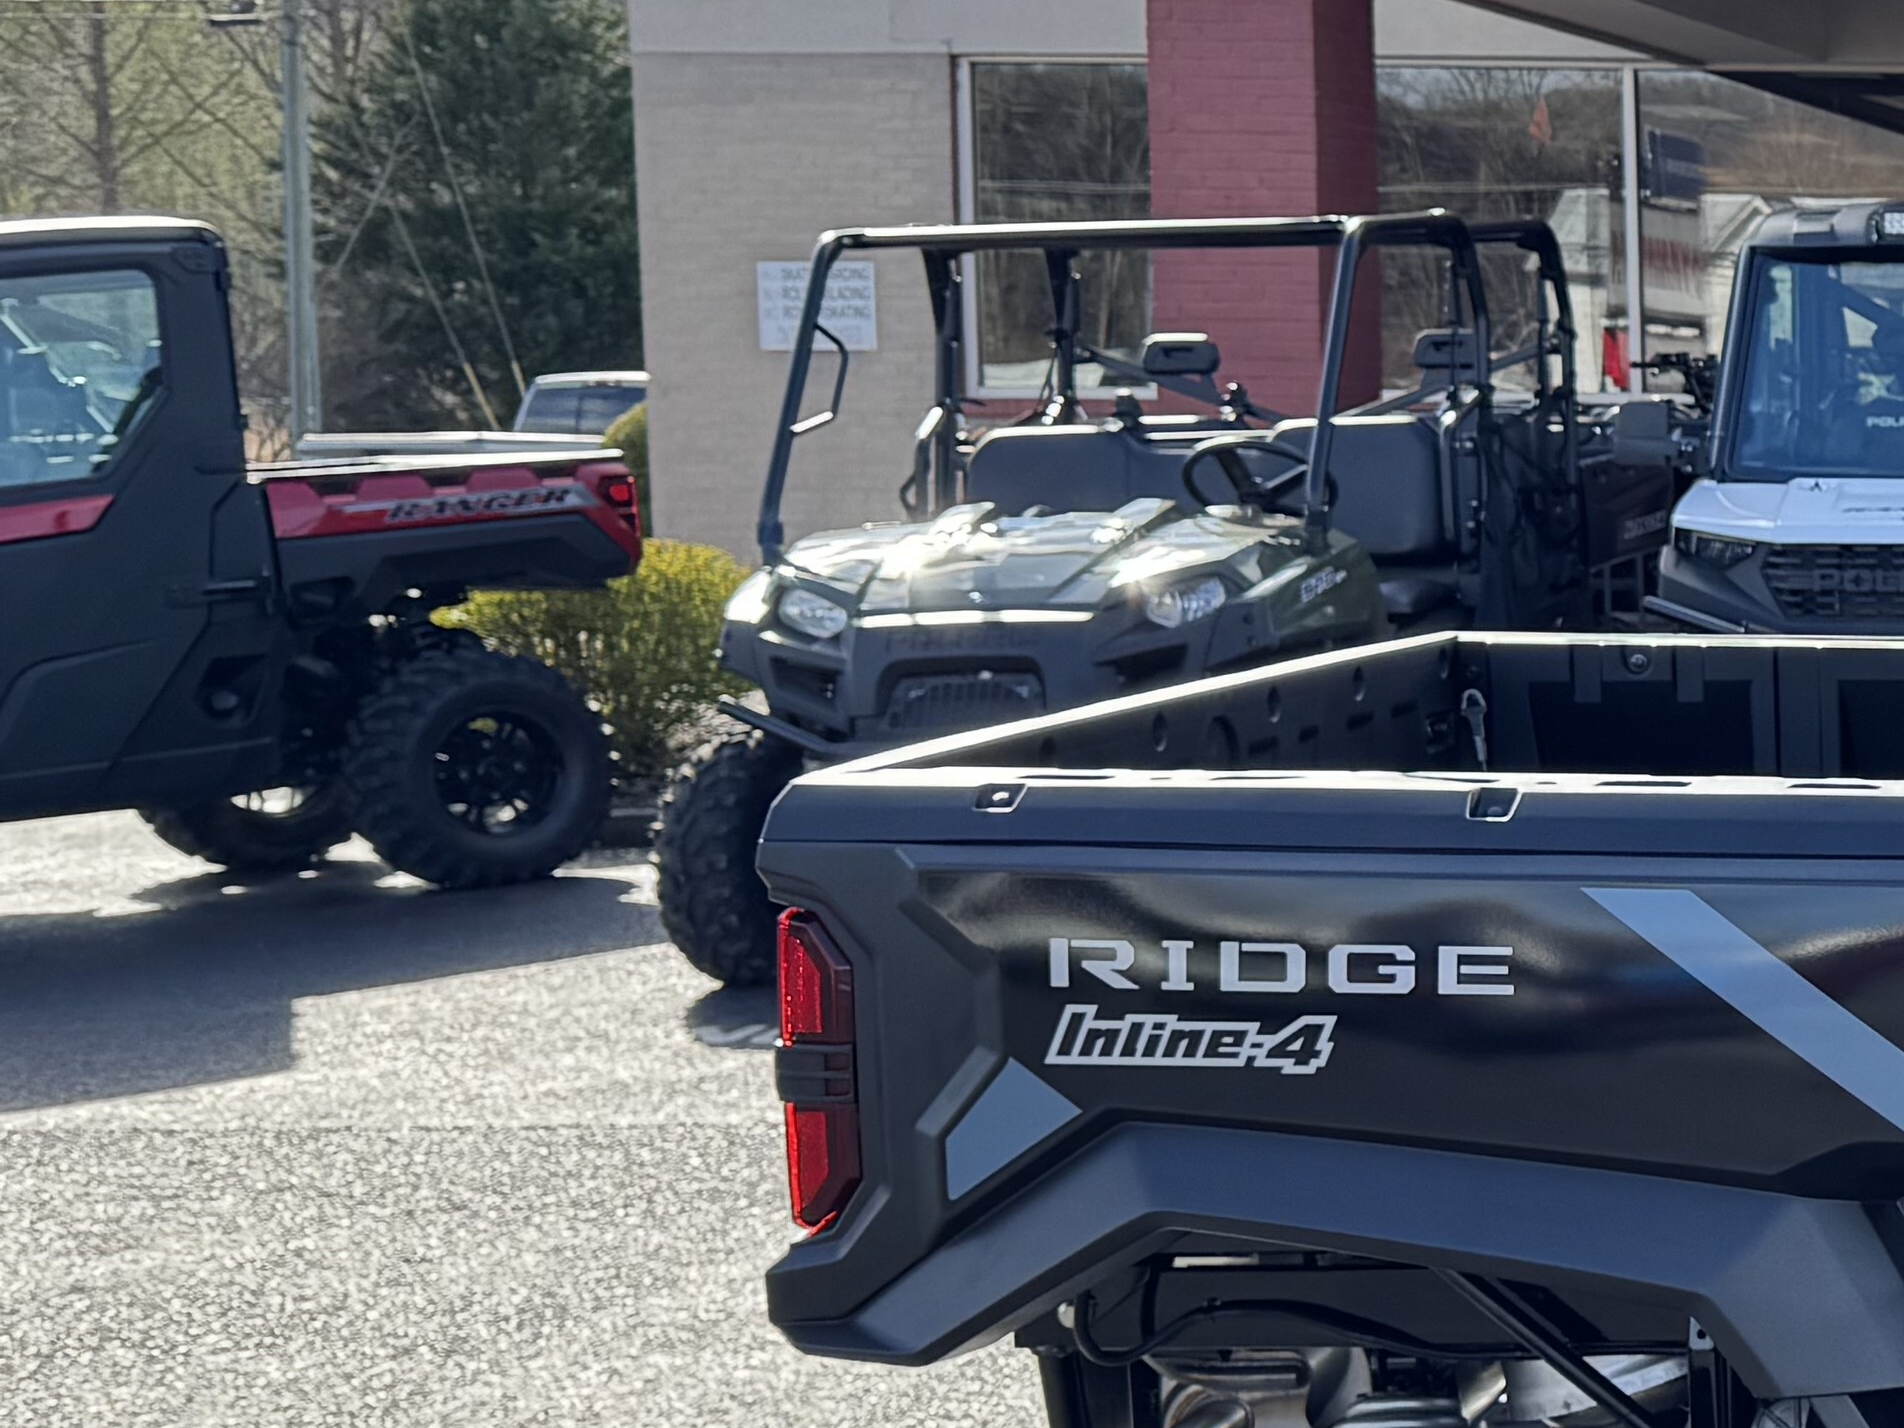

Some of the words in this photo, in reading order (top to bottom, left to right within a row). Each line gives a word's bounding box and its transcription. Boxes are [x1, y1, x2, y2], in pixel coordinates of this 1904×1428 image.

[384, 487, 574, 522] RANGER
[1048, 937, 1515, 996] RIDGE
[1044, 1003, 1338, 1074] Inline-4
